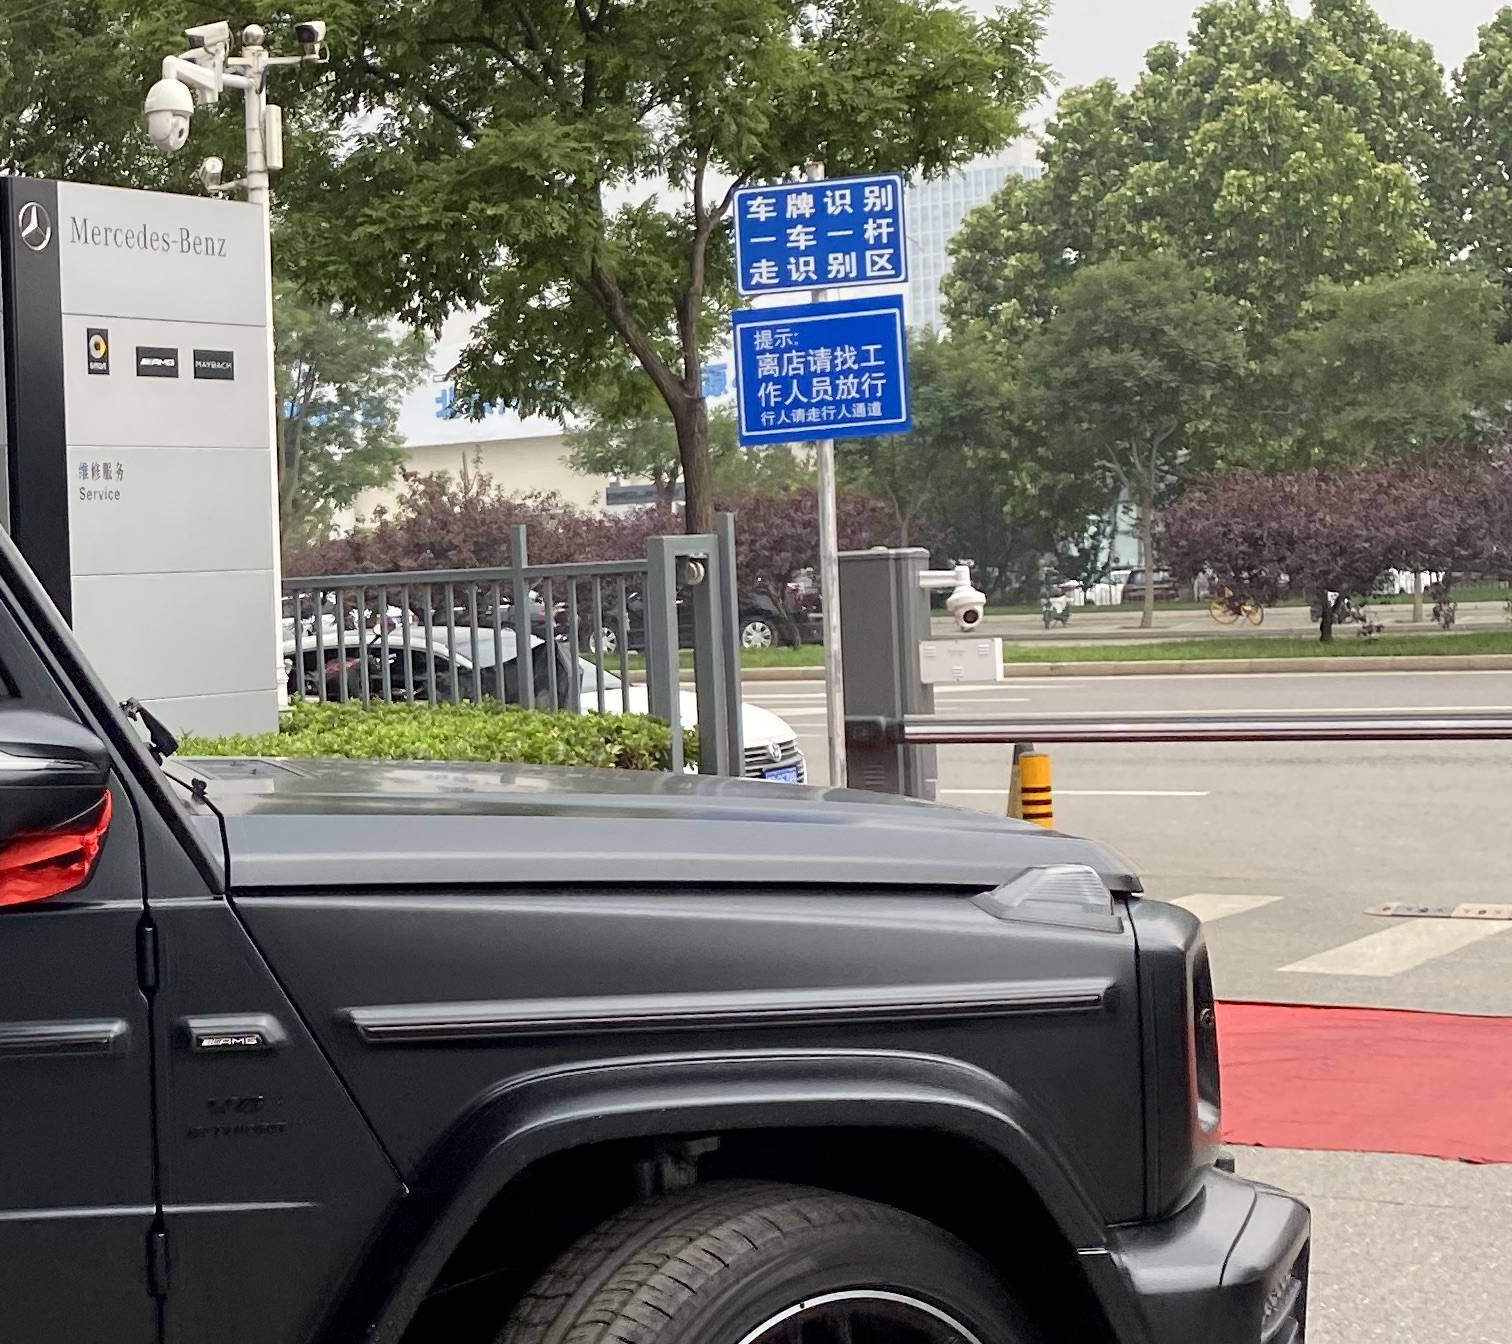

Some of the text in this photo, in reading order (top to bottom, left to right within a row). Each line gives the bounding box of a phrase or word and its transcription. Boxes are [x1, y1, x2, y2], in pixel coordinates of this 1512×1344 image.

[746, 184, 893, 222] 车牌识别
[70, 216, 228, 257] Mercedes-Benz
[749, 218, 895, 251] 一车一杆
[749, 248, 896, 285] 走识别区
[195, 359, 232, 370] MAYBACH
[756, 343, 886, 379] 离店请找工
[757, 371, 887, 408] 作人员放行
[760, 400, 883, 427] 行人请走行人通道
[78, 461, 124, 482] 维修服务
[79, 486, 121, 501] Service
[219, 1036, 258, 1046] AMG
